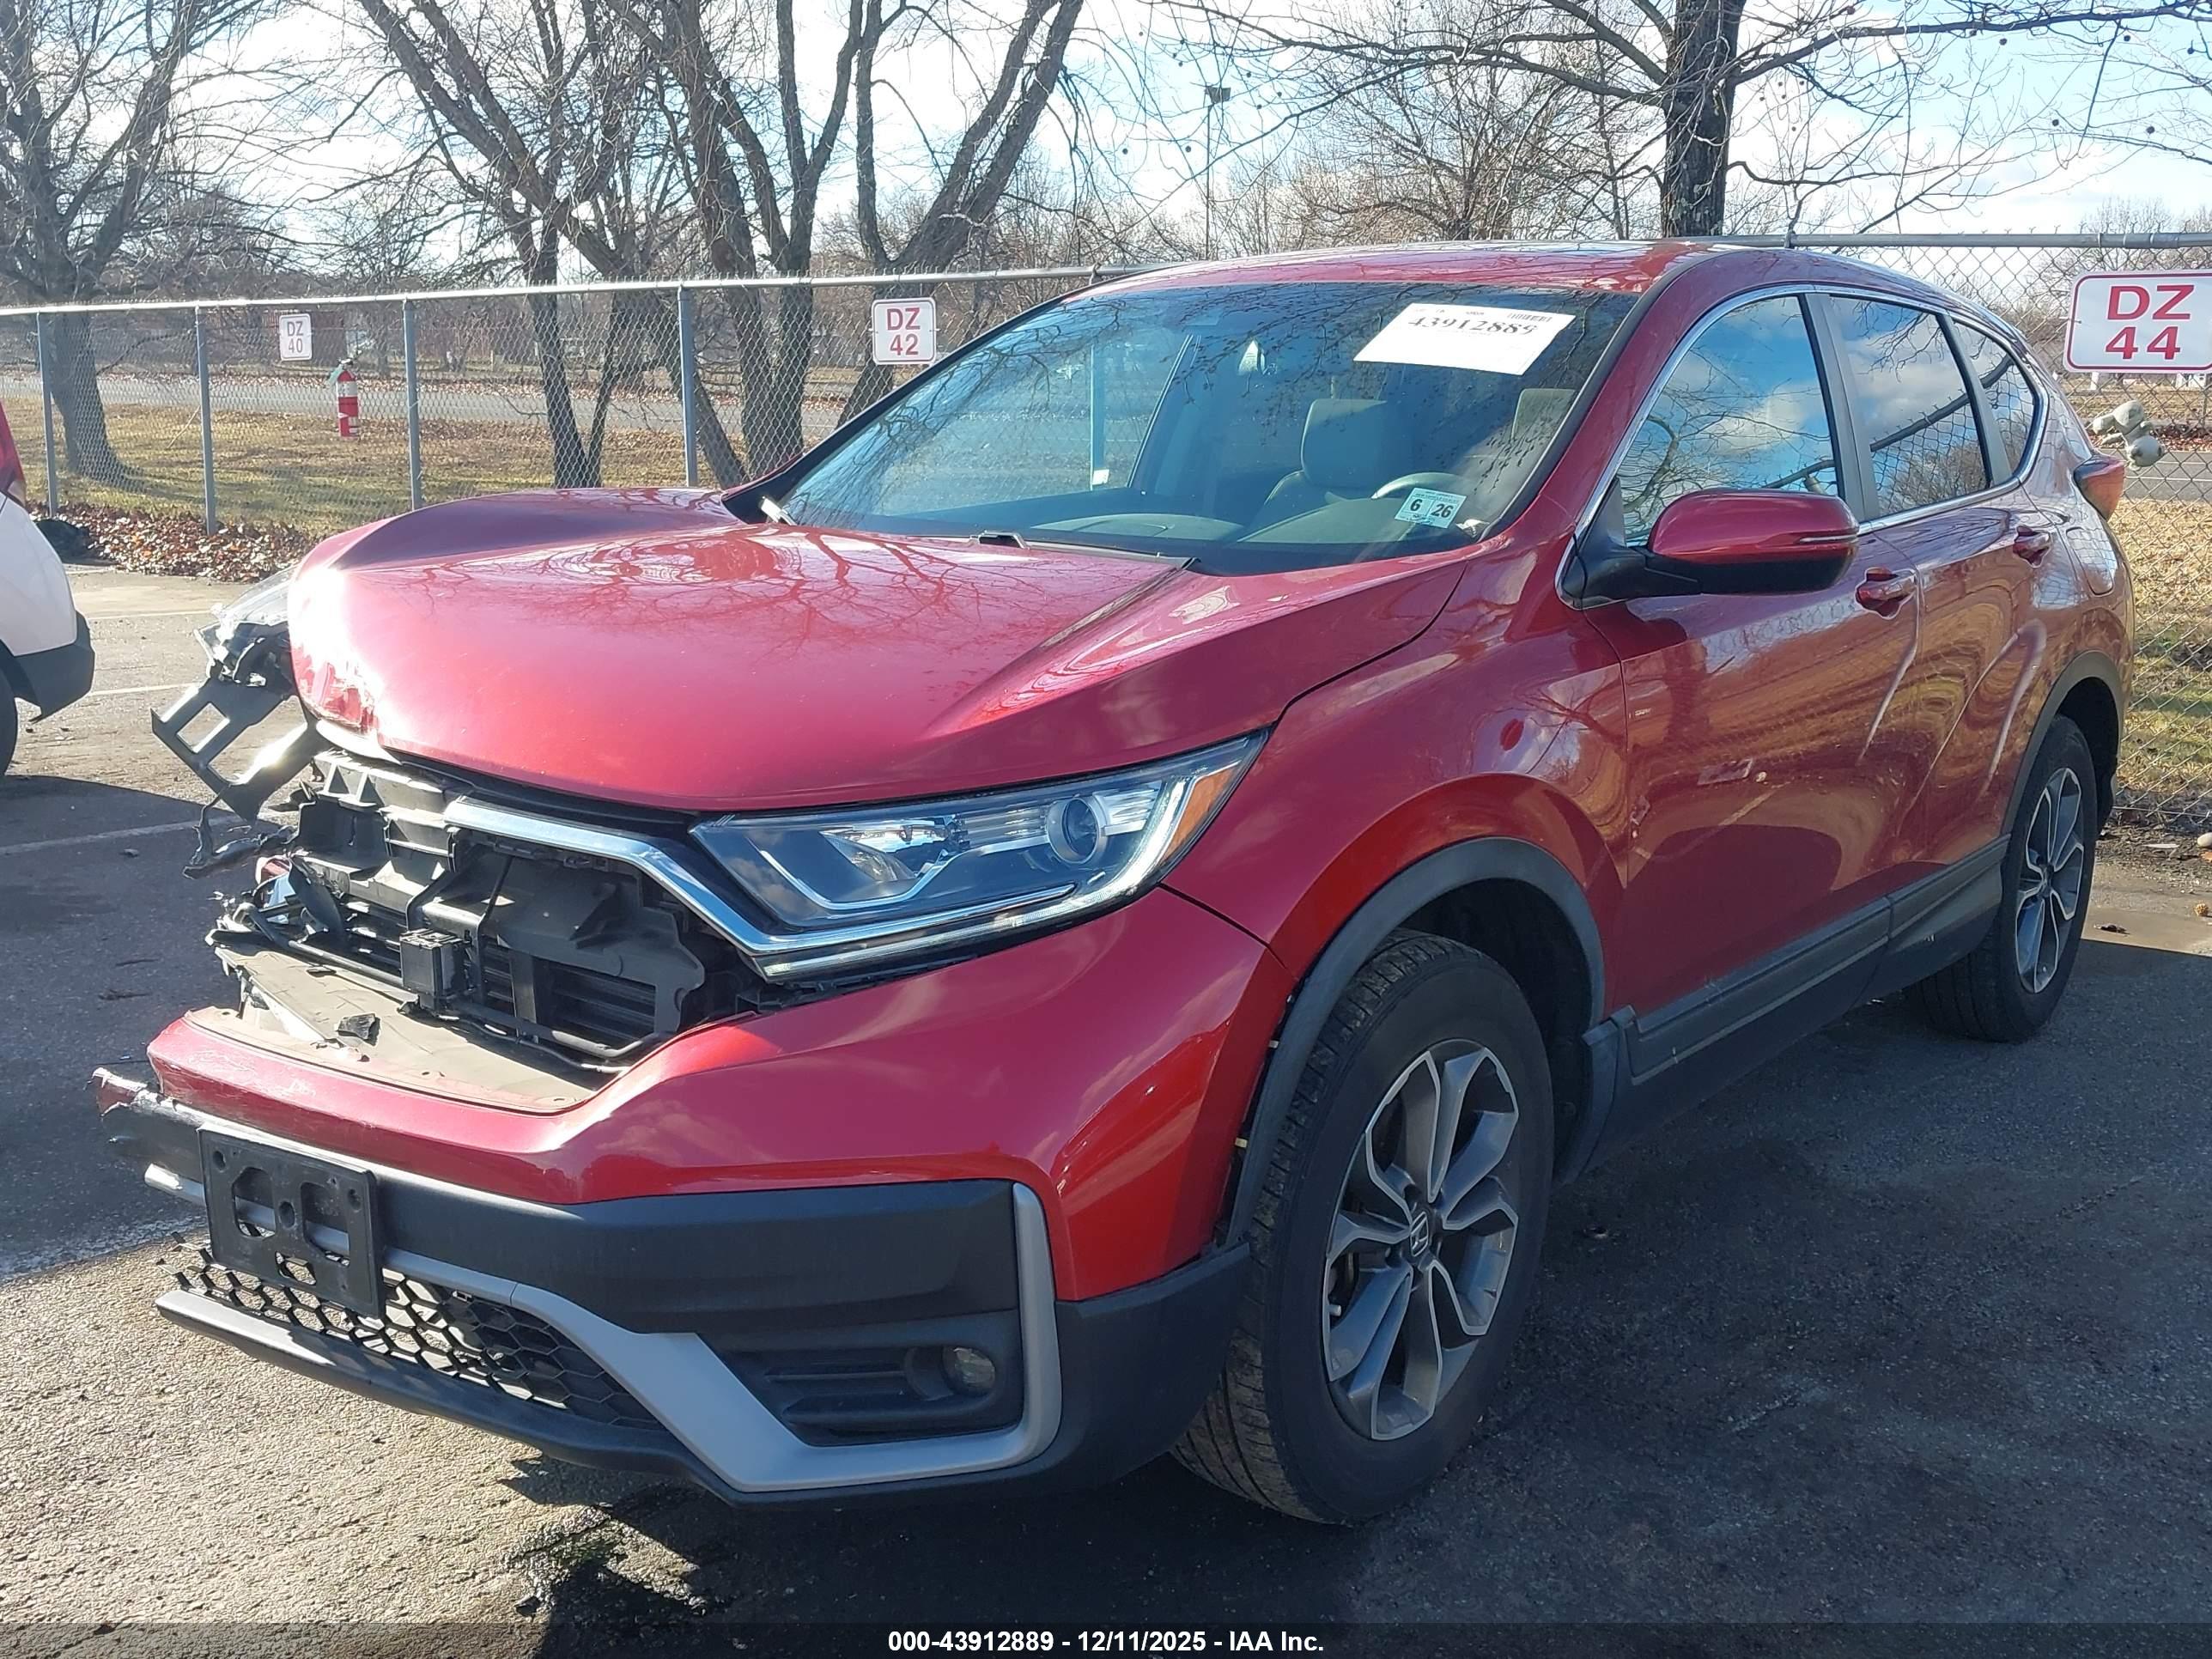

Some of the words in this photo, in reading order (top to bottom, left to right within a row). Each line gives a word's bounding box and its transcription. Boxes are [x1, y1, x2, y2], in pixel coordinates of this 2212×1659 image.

[2107, 284, 2195, 320] DZ
[287, 320, 304, 337] DZ
[886, 307, 921, 331] DZ
[288, 337, 303, 353] 40
[890, 332, 919, 356] 42
[2105, 325, 2181, 361] 44
[1410, 498, 1423, 512] 6
[1431, 502, 1454, 519] 26
